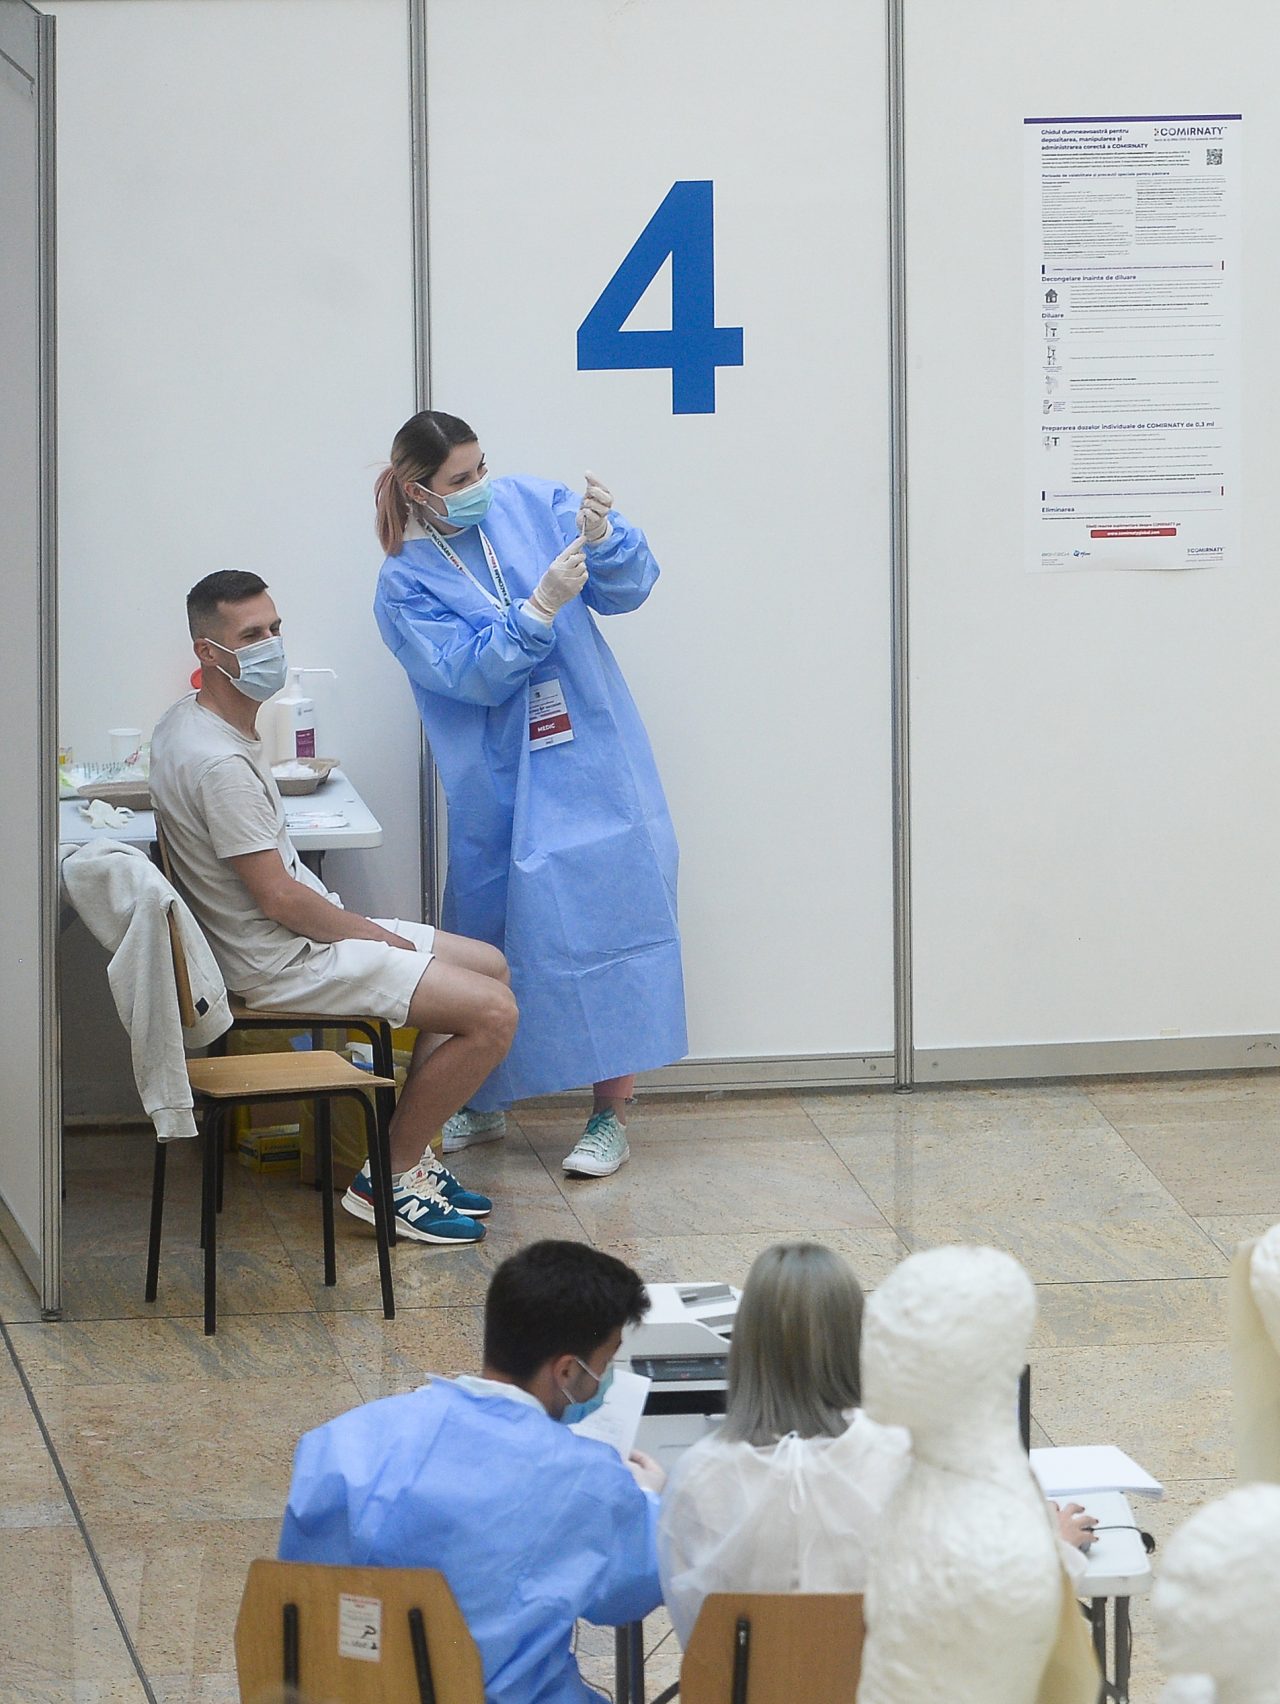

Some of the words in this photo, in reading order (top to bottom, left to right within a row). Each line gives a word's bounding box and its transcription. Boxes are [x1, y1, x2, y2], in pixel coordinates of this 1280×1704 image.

[1160, 126, 1224, 136] COMIRNATY
[577, 180, 743, 414] 4
[537, 723, 555, 732] MEDIC
